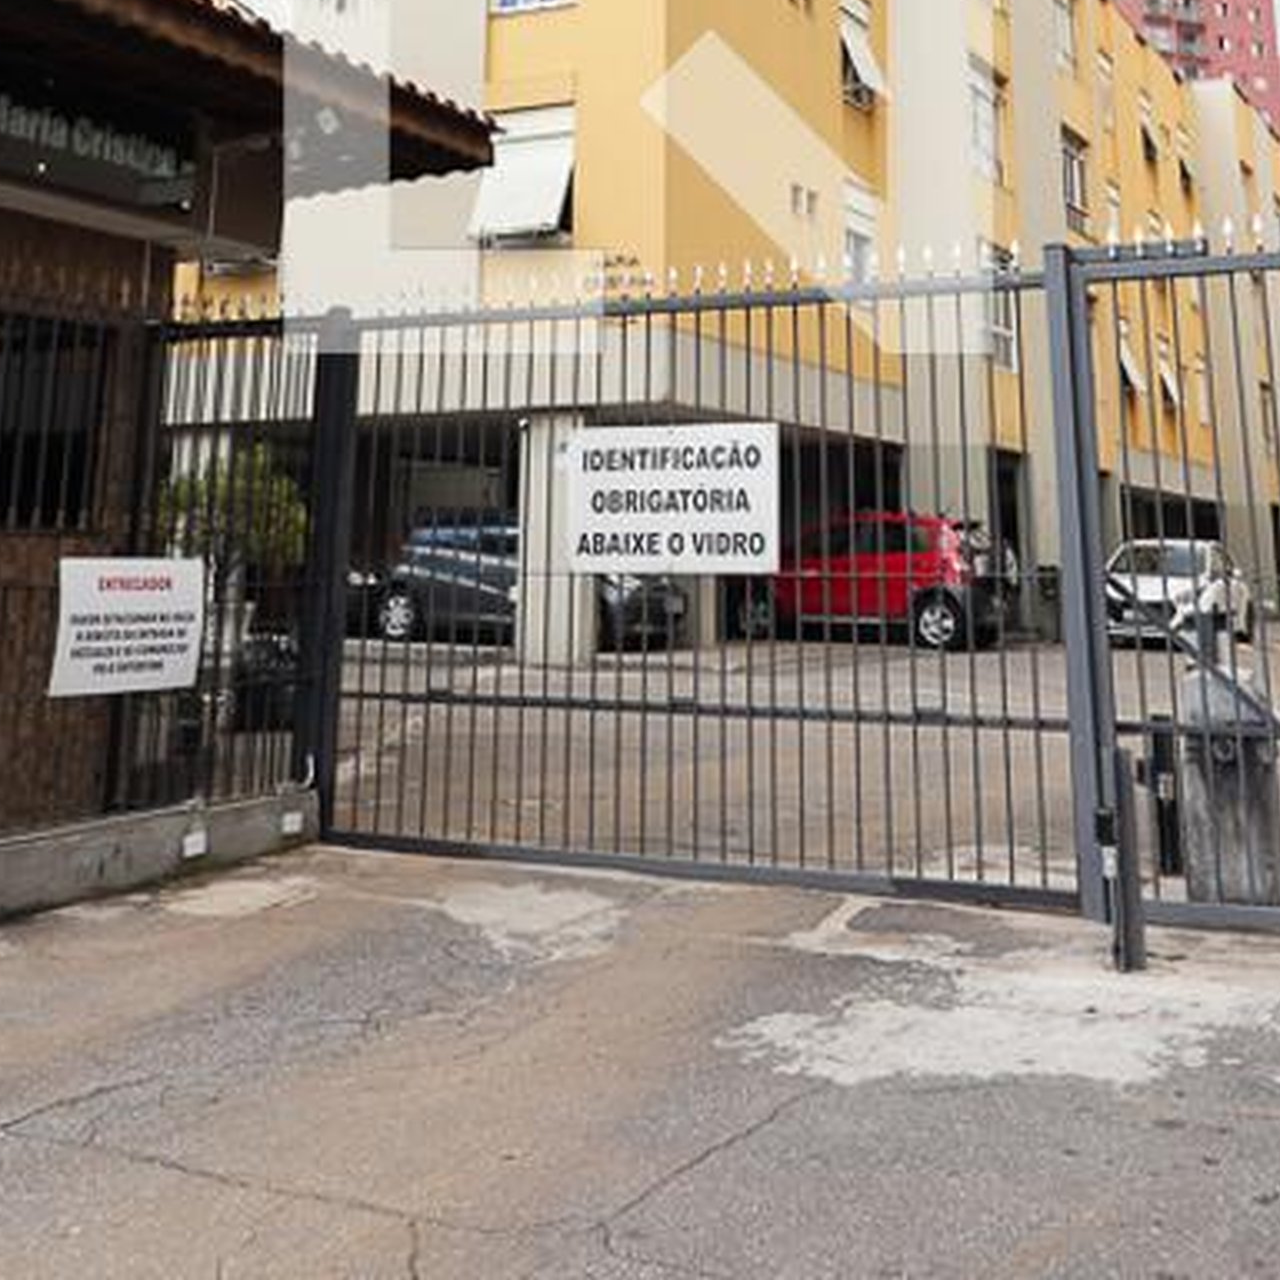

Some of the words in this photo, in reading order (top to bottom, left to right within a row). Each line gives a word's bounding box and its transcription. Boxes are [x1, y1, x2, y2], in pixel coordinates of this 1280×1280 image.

[590, 484, 751, 514] OBRIGATÓRIA
[576, 532, 661, 557] ABAIXE
[667, 532, 685, 557] O
[691, 532, 766, 557] VIDRO
